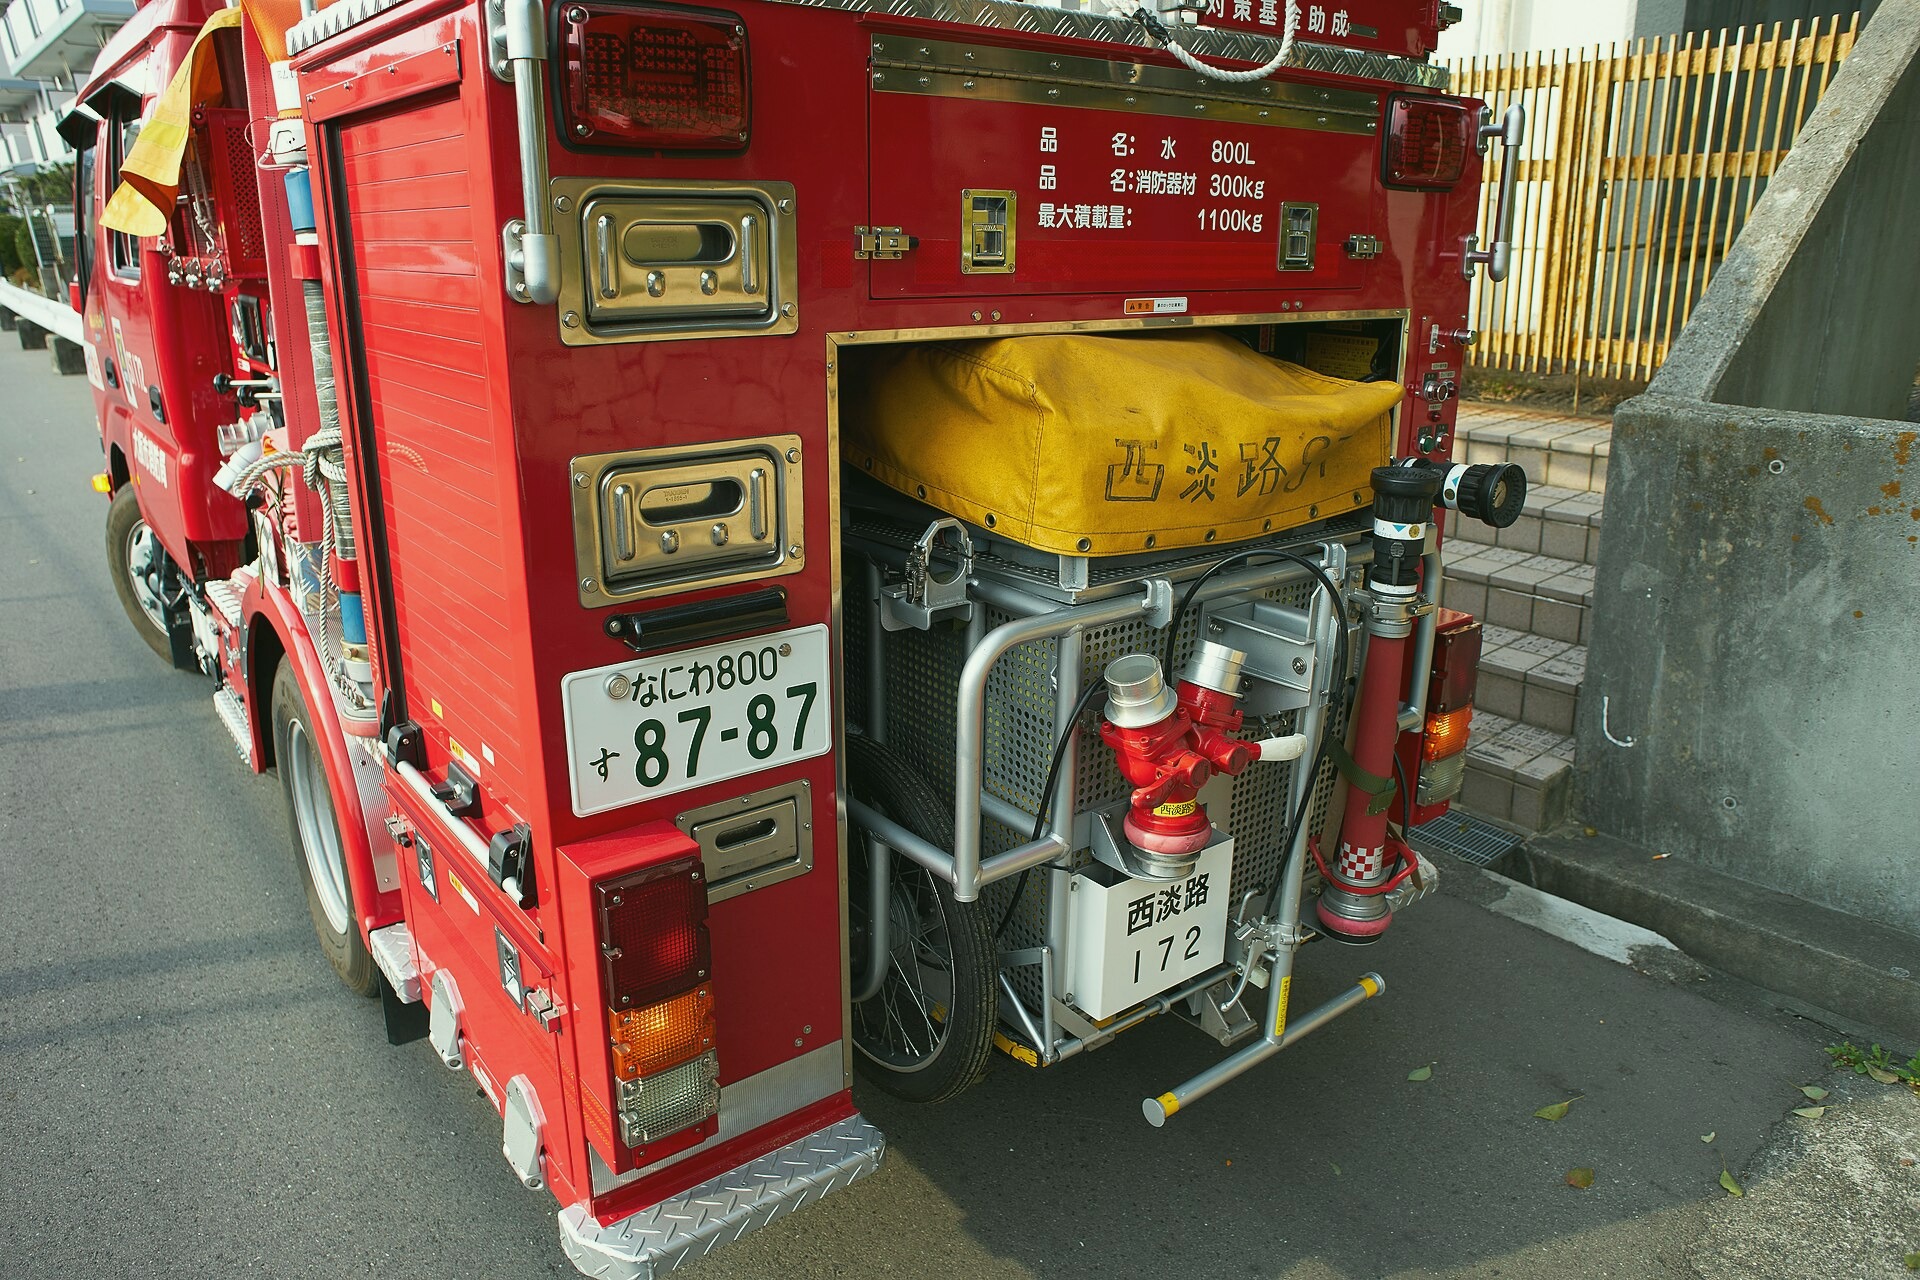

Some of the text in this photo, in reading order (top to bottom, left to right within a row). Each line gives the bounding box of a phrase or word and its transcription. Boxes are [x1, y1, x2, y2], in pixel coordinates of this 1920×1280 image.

[1160, 135, 1177, 160] 水
[1211, 140, 1256, 165] 800L
[1209, 173, 1266, 200] 300kg
[1197, 208, 1263, 233] 1100kg
[589, 681, 818, 788] す 87-87
[1126, 872, 1210, 937] 西淡路
